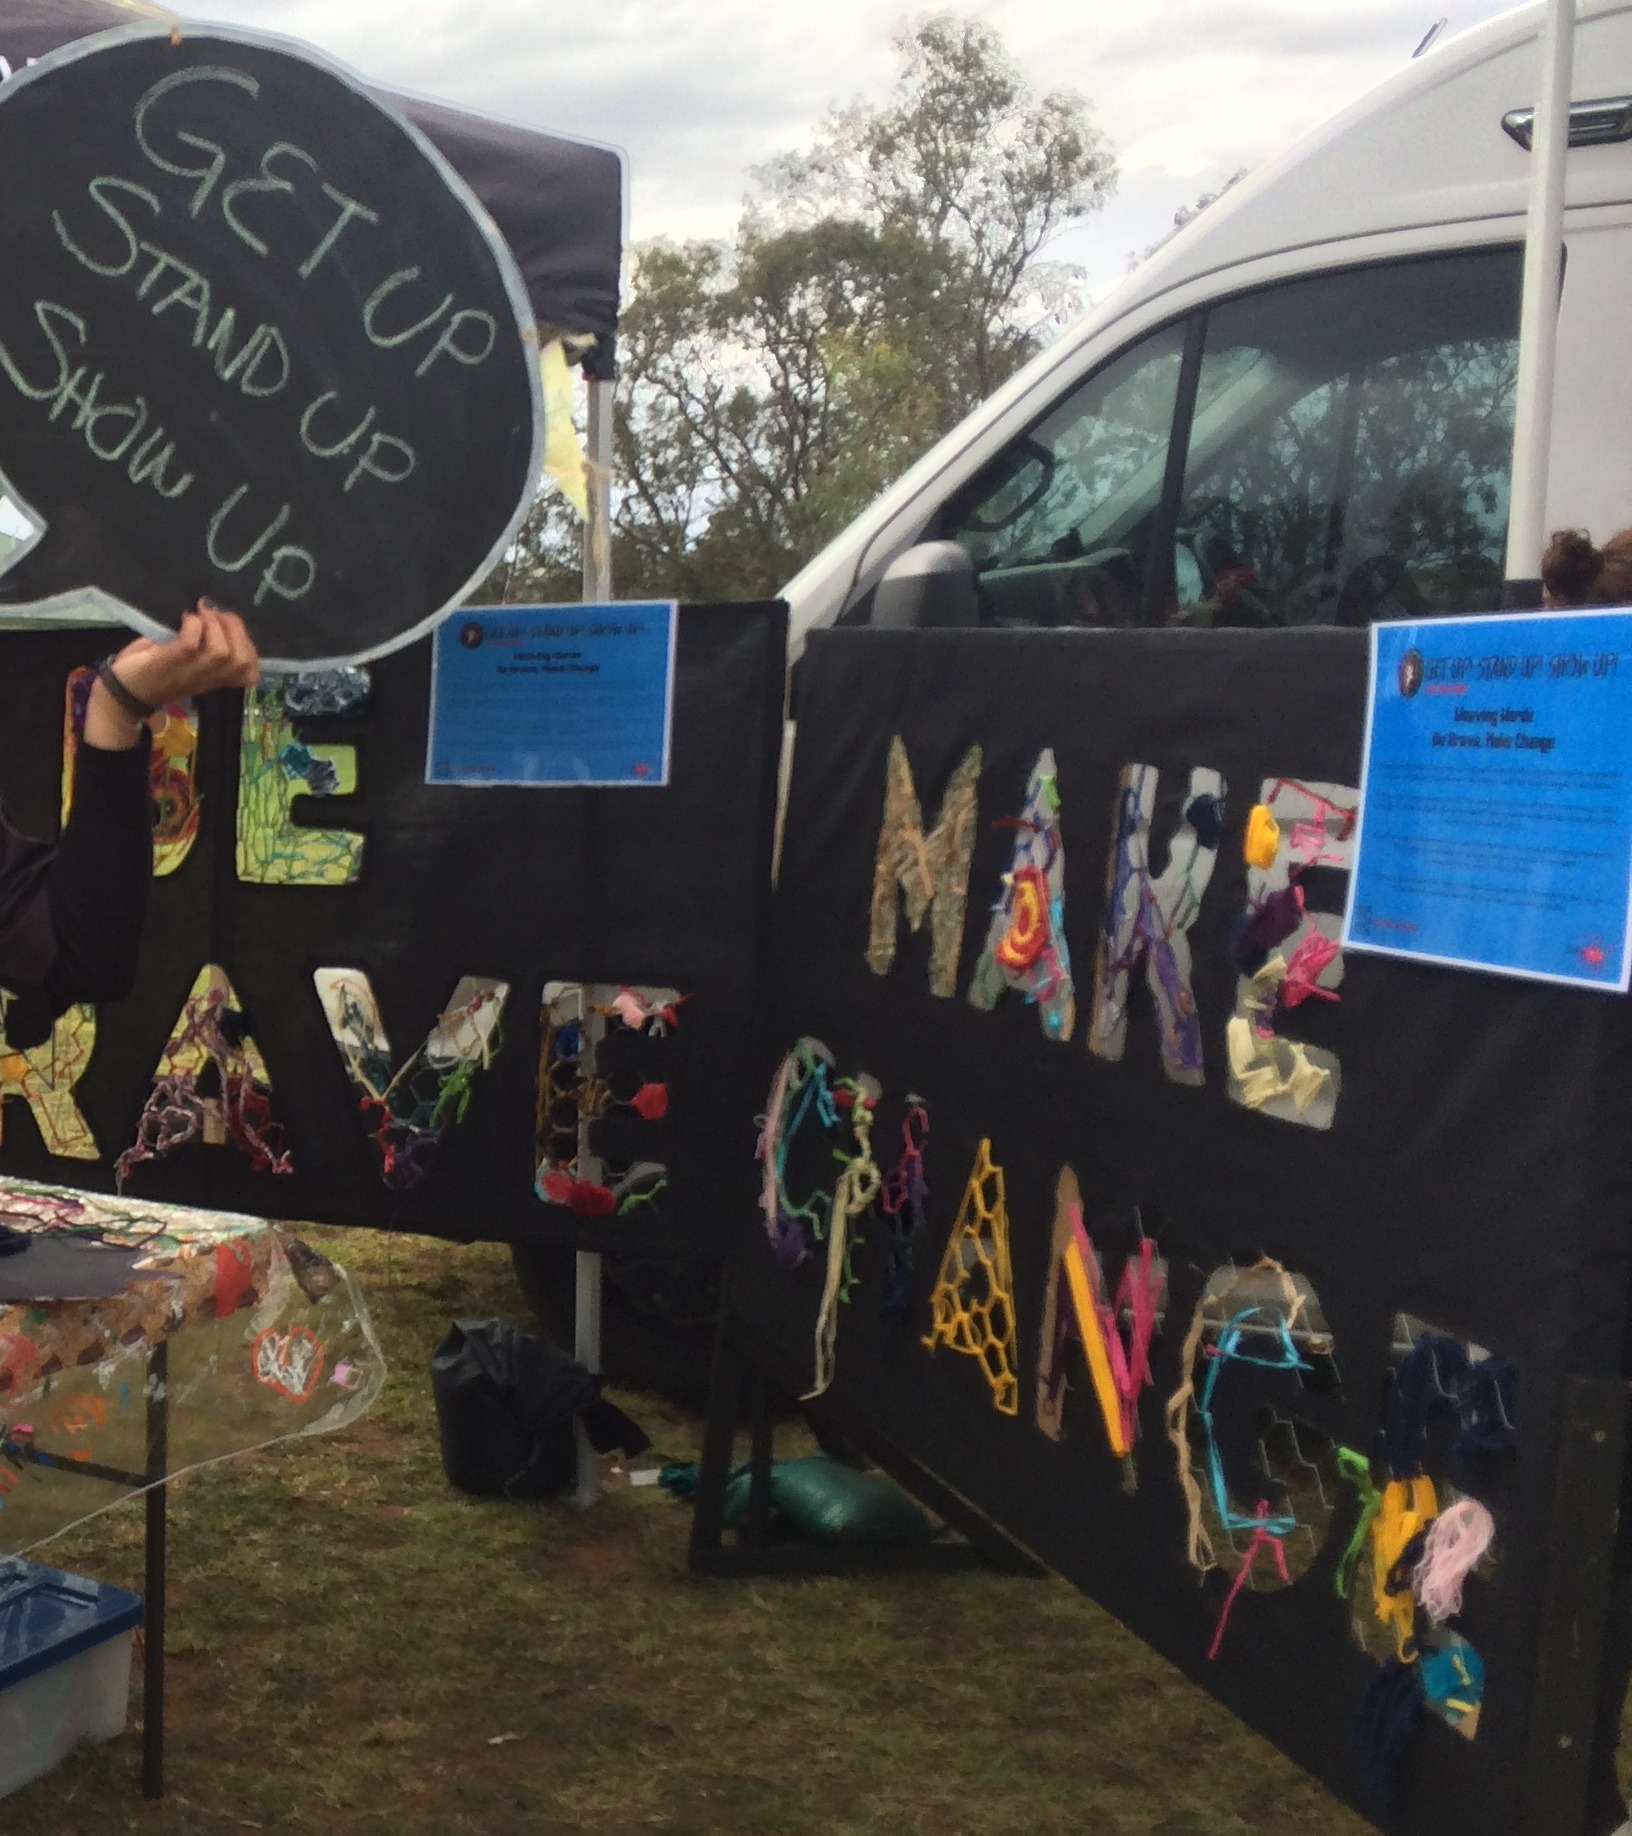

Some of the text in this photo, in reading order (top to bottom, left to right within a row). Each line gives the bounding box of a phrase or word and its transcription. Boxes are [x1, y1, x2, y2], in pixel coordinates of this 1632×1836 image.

[52, 176, 416, 492] STAND UP
[135, 64, 496, 377] GET UP
[207, 484, 315, 606] UP
[862, 734, 1361, 1131] MAKE
